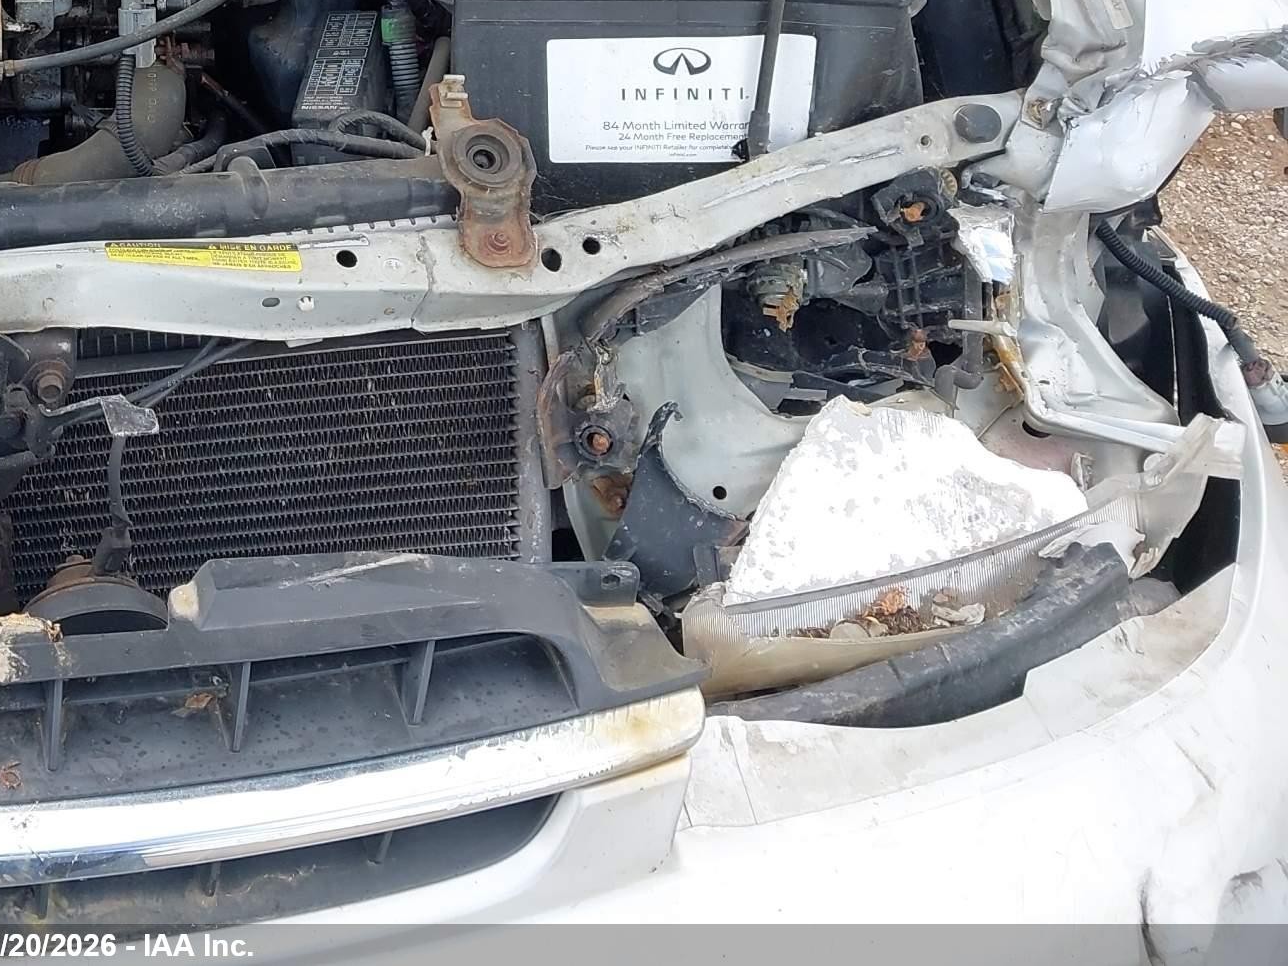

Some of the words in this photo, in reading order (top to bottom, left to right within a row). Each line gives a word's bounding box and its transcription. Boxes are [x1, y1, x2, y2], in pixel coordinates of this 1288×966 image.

[621, 87, 745, 101] INFINITI
[603, 121, 619, 131] 84
[622, 121, 661, 131] Month
[664, 121, 706, 130] Limited
[619, 133, 631, 141] 24
[633, 133, 664, 141] Month
[667, 133, 687, 141] Free
